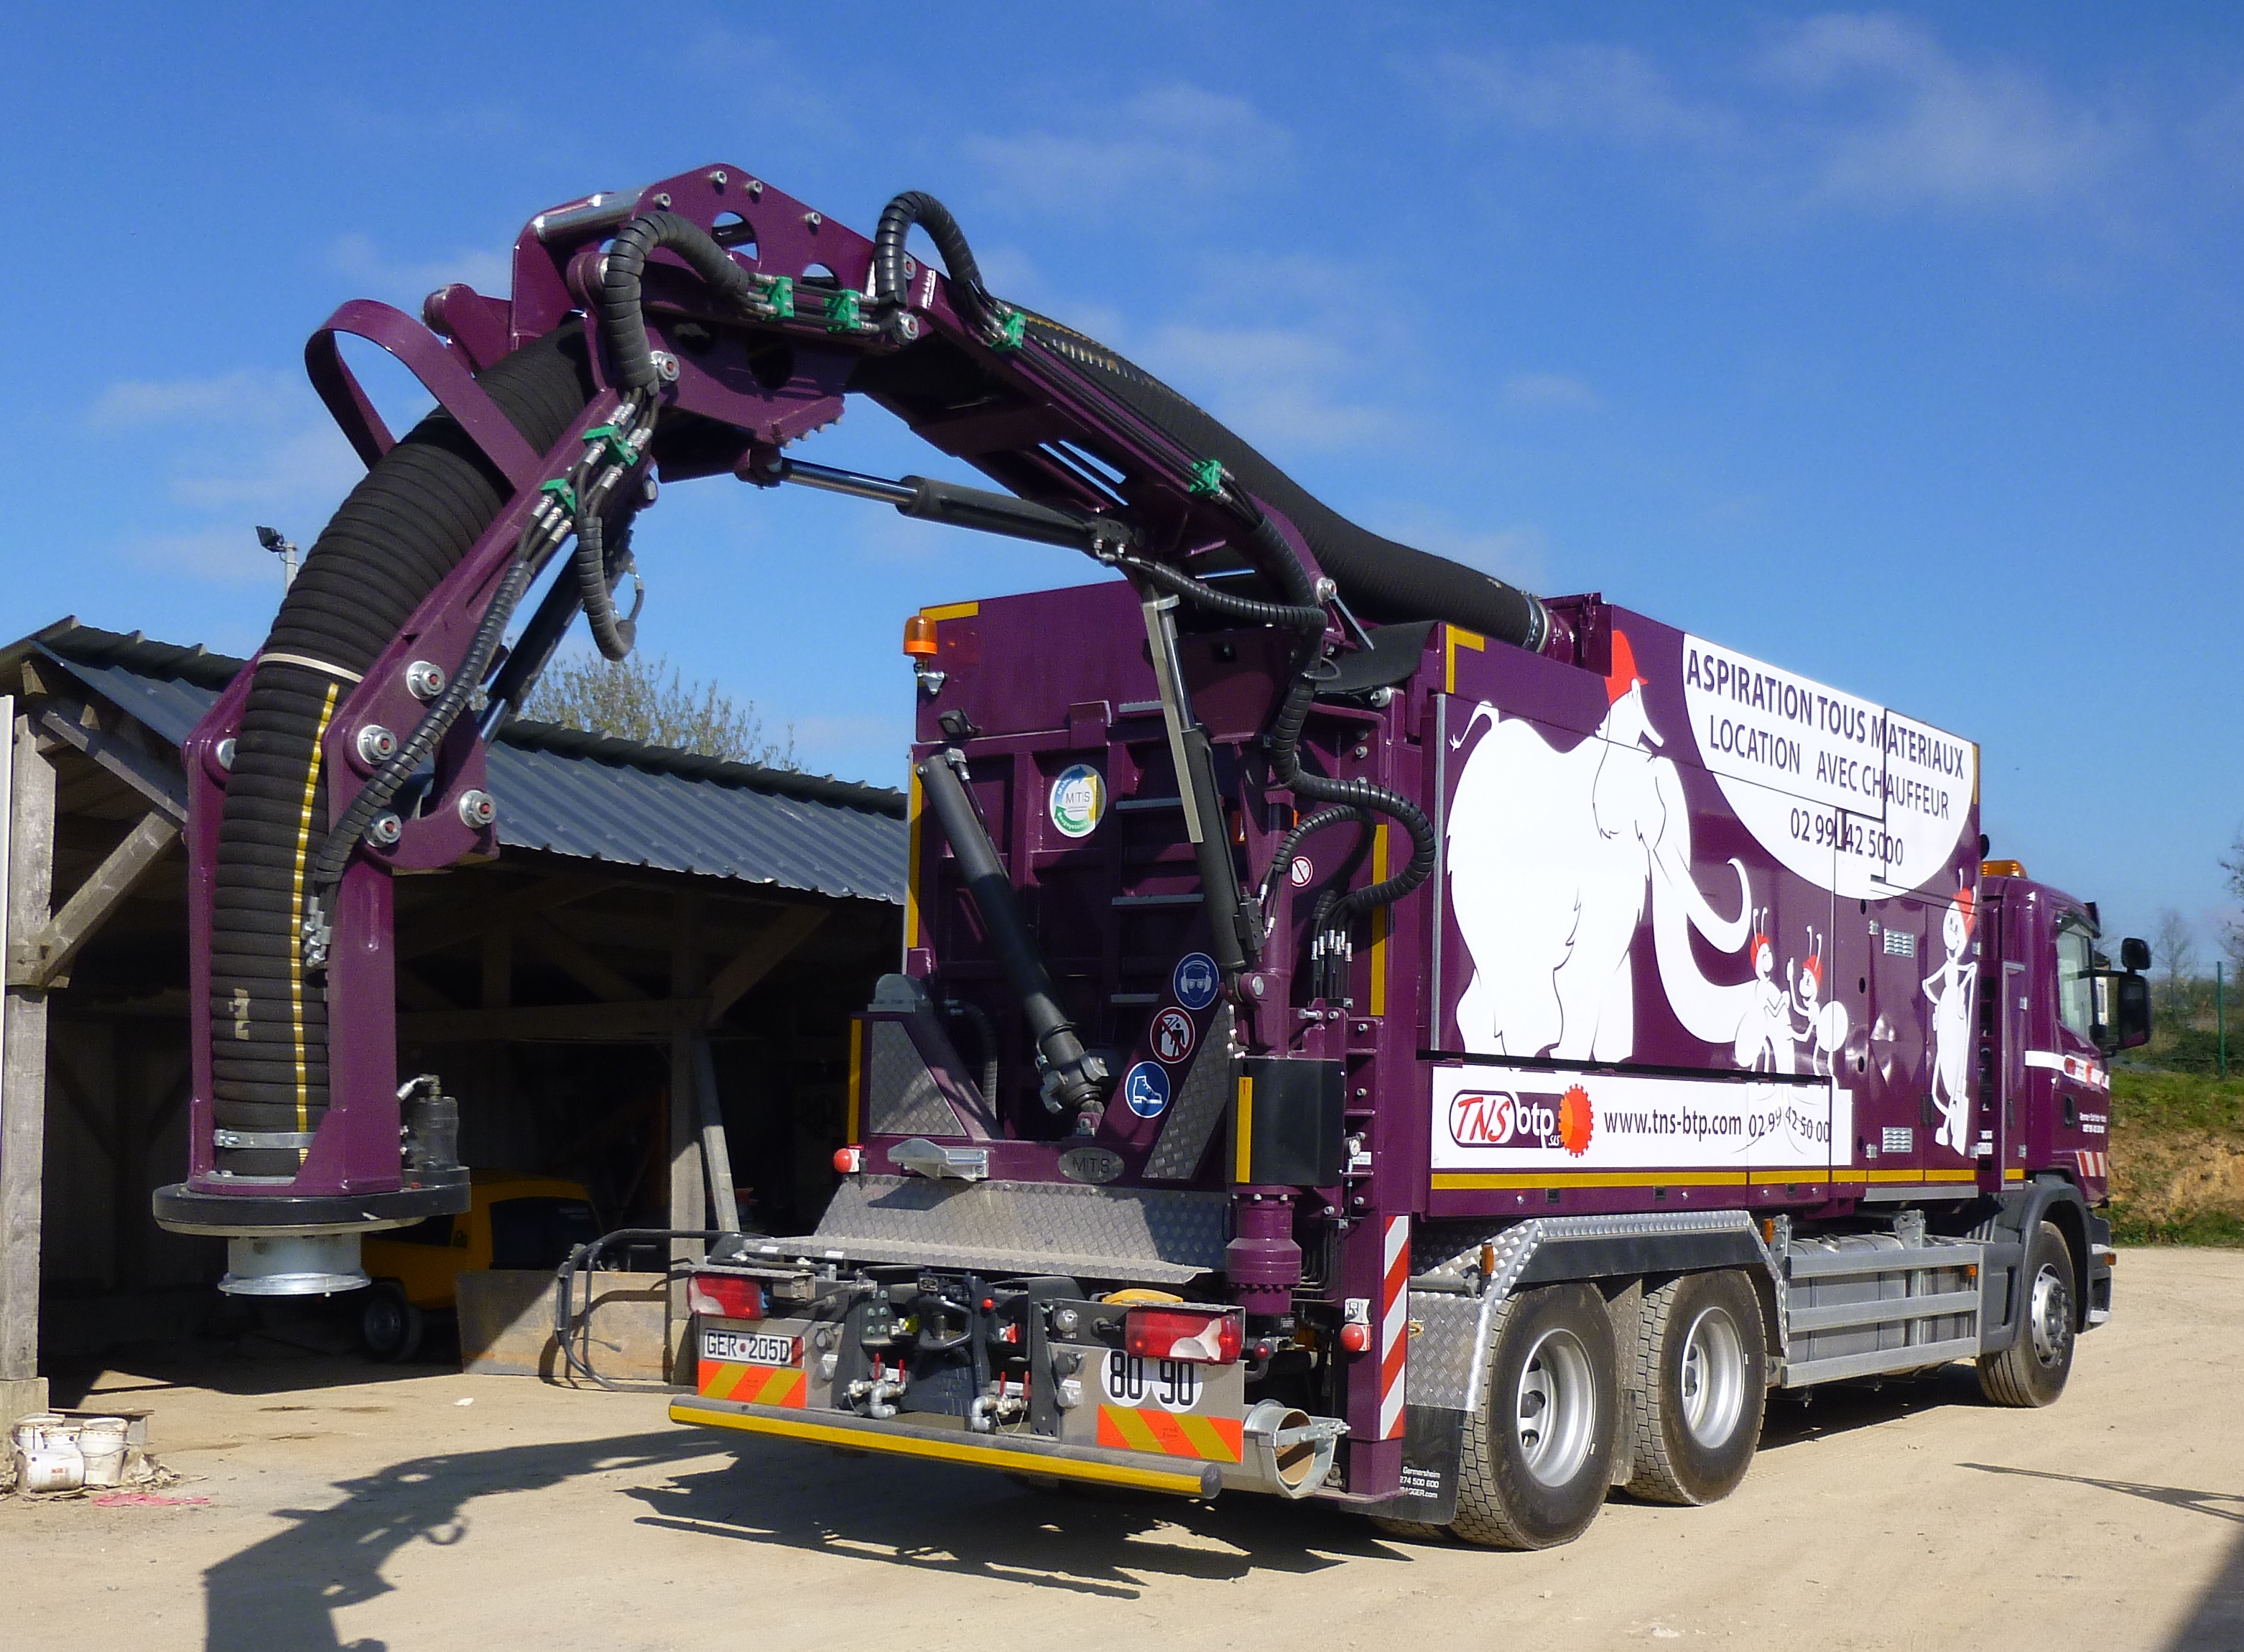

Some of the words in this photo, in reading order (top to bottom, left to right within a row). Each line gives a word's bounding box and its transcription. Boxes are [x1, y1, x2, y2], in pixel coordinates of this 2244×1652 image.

[1687, 649, 1812, 726] ASPIRATION
[1817, 695, 1865, 744] TOUS
[1870, 715, 1964, 780] MATERIAUX
[1710, 715, 1800, 775] LOCATION
[1816, 751, 1858, 792] AVEC
[1862, 765, 1949, 820] CHAUFFEUR
[1065, 792, 1090, 804] MTS
[1791, 807, 1810, 842] 02
[1815, 814, 1835, 847] 99
[1845, 823, 1863, 855] 42
[1457, 1096, 1511, 1142] TNS
[1513, 1092, 1554, 1148] btp
[1604, 1106, 1742, 1142] www.tns-btp.com
[1749, 1114, 1765, 1138] 02
[1786, 1106, 1796, 1131] 42
[1072, 1157, 1110, 1173] MTS
[708, 1333, 737, 1357] GER
[748, 1337, 790, 1362] 205D
[1110, 1350, 1144, 1400] 80
[1159, 1358, 1194, 1406] 90
